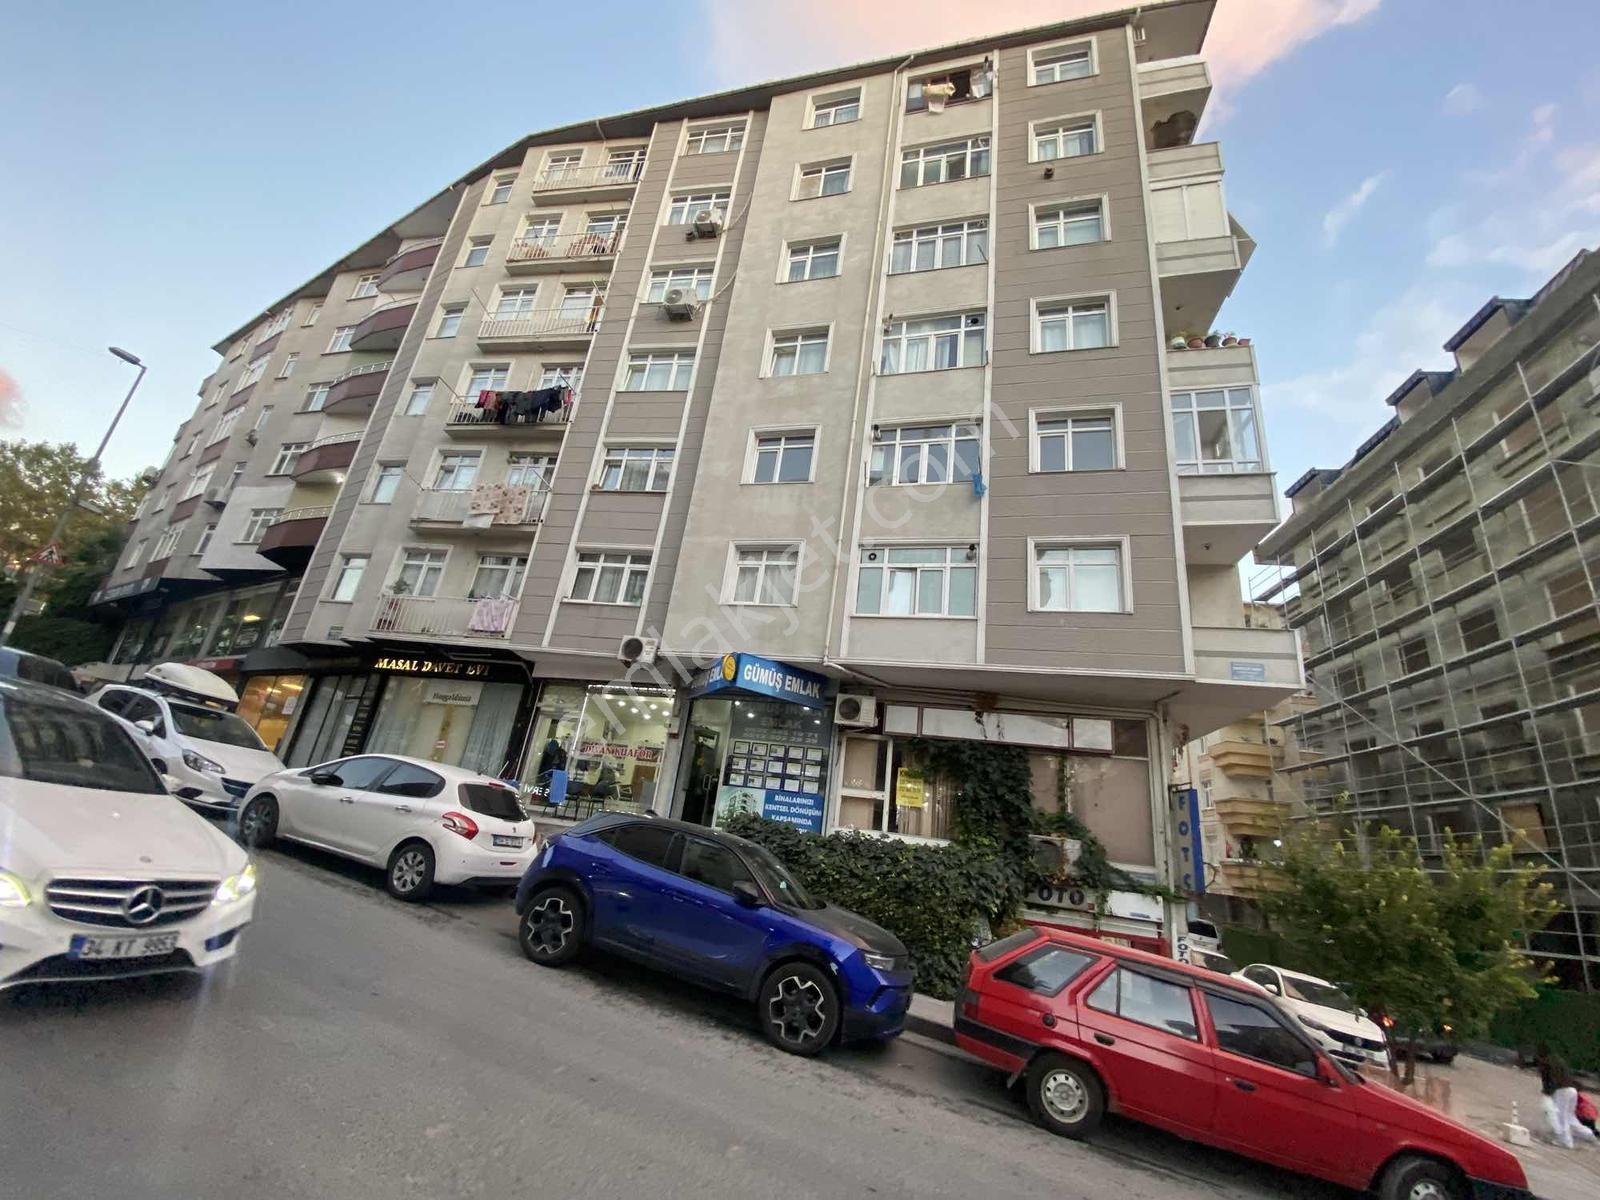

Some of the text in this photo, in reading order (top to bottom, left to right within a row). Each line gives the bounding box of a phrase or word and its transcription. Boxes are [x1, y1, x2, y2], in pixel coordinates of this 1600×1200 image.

[374, 658, 419, 671] MASAL
[421, 661, 462, 673] DAVET
[743, 664, 820, 699] GÜMÜŞ EMLAK
[765, 803, 822, 817] KENTSEL DÖNÜŞÜM
